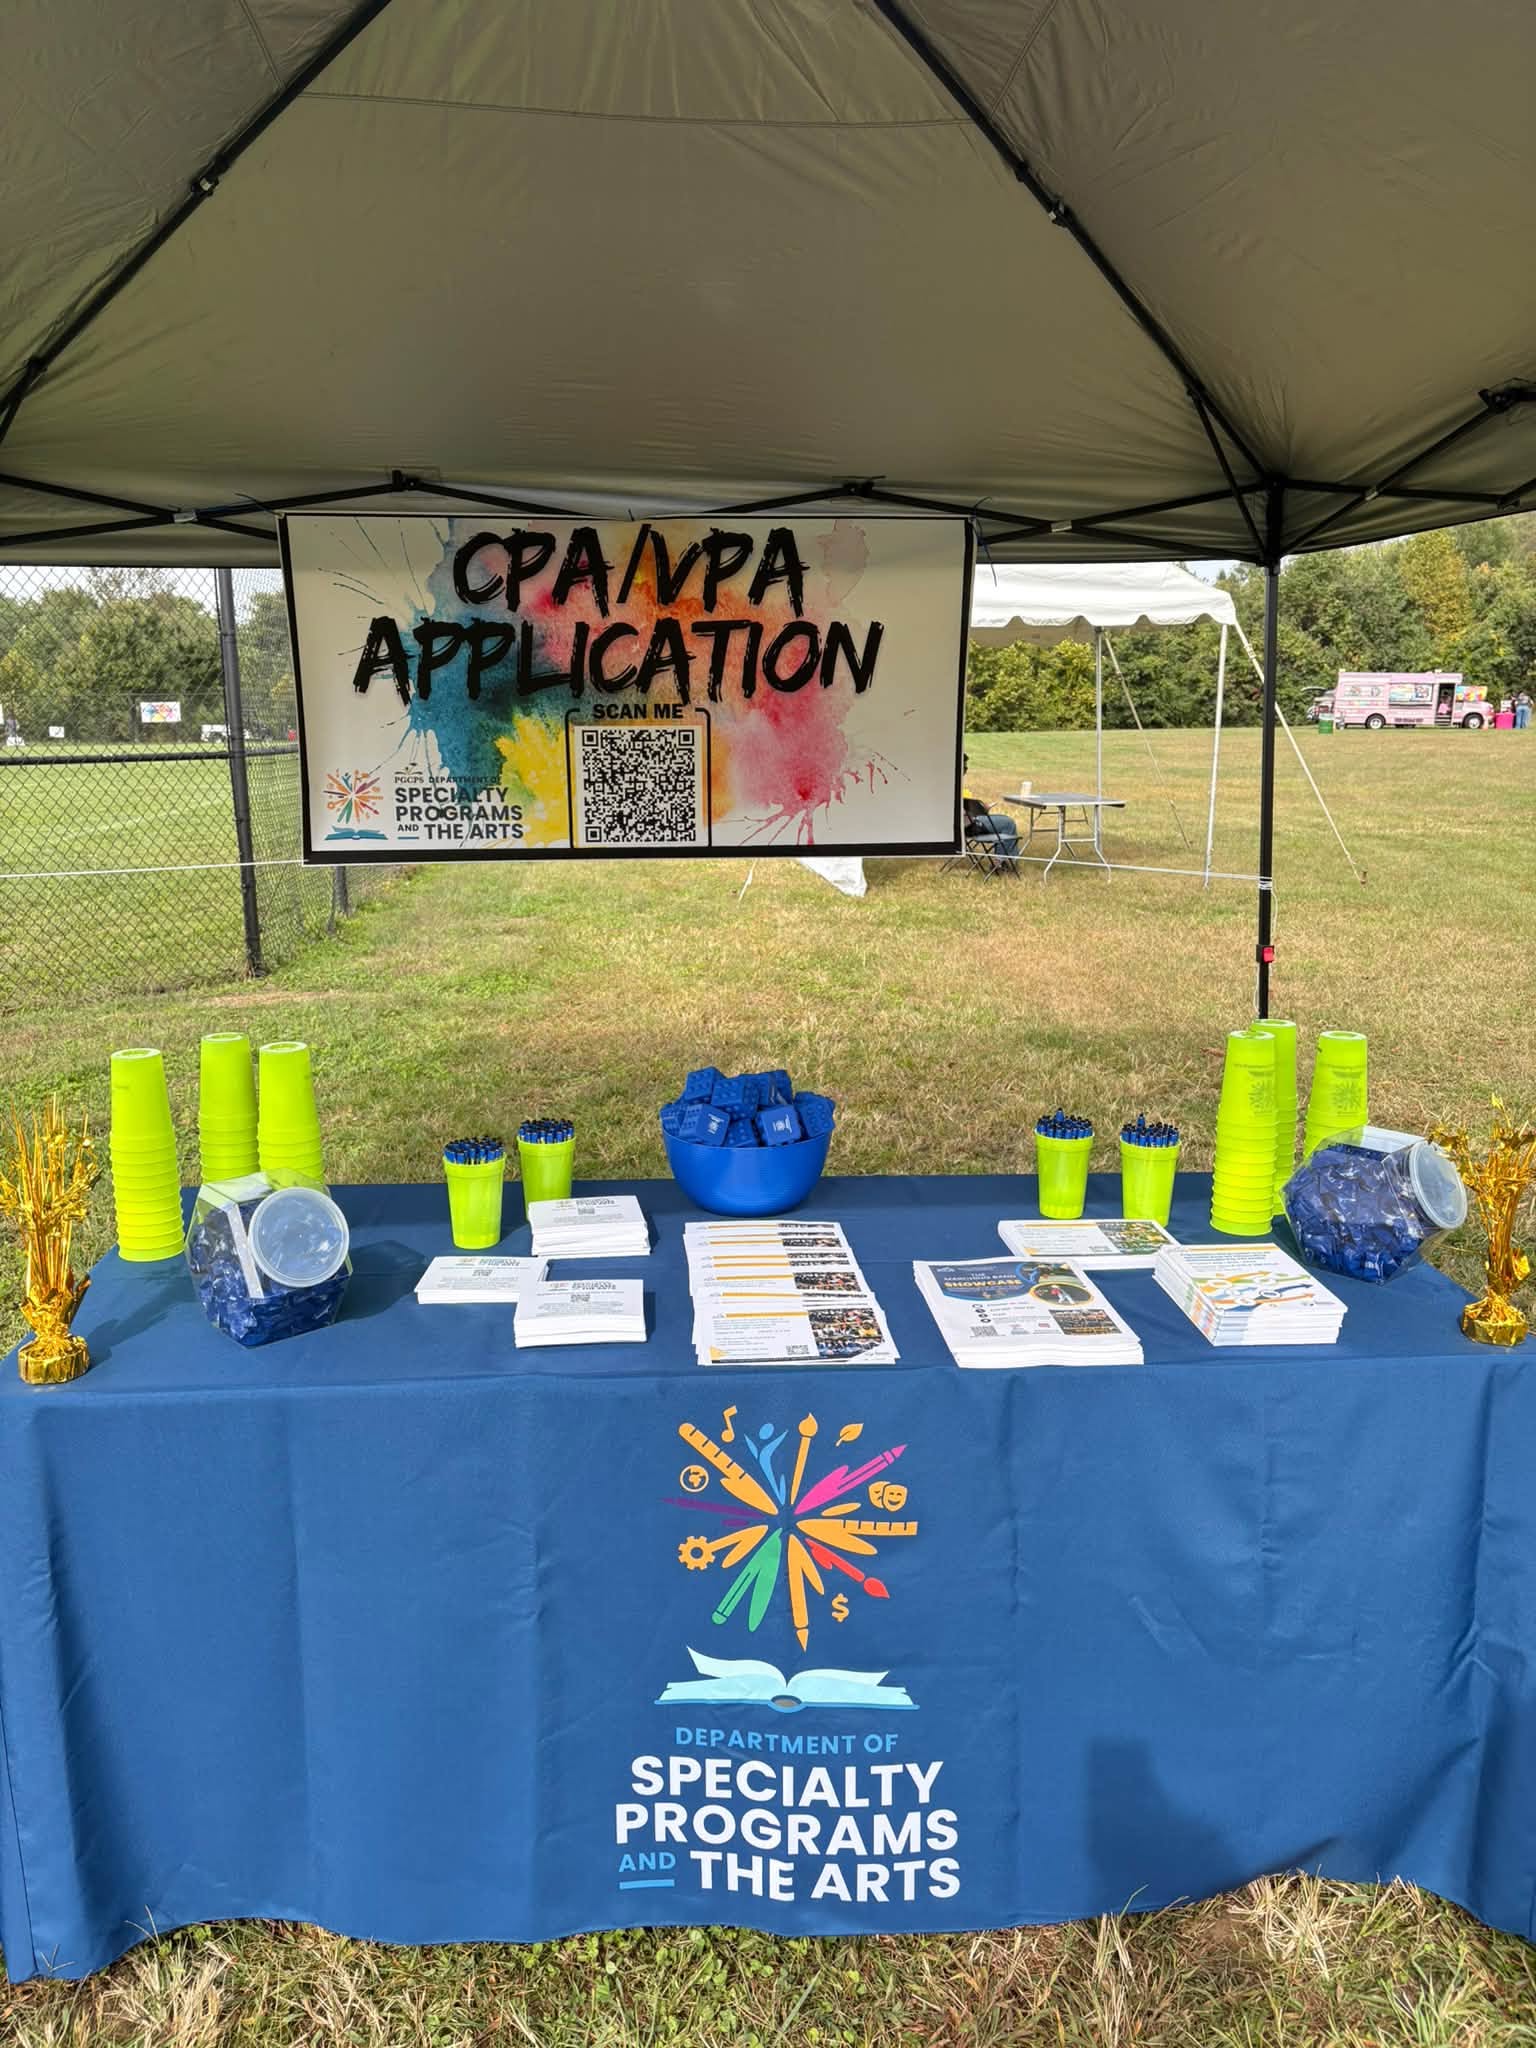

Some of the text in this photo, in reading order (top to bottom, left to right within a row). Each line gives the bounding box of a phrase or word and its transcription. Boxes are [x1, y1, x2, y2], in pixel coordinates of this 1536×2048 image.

[453, 523, 810, 618] CPA/VPA
[353, 614, 885, 706] APPLICATION
[593, 703, 684, 719] SCAN ME
[395, 776, 424, 784] PGCPS
[429, 776, 488, 784] DEPARTMENT
[395, 787, 509, 803] SPECIALTY
[396, 805, 523, 821] PROGRAMS
[398, 823, 524, 839] AND THE ARTS
[943, 1280, 1023, 1288] SHOWCASE
[676, 1727, 898, 1754] DEPARTMENT OF
[631, 1755, 944, 1808] SPECIALTY
[616, 1802, 959, 1856] PROGRAMS
[619, 1850, 961, 1902] AND THE ARTS
